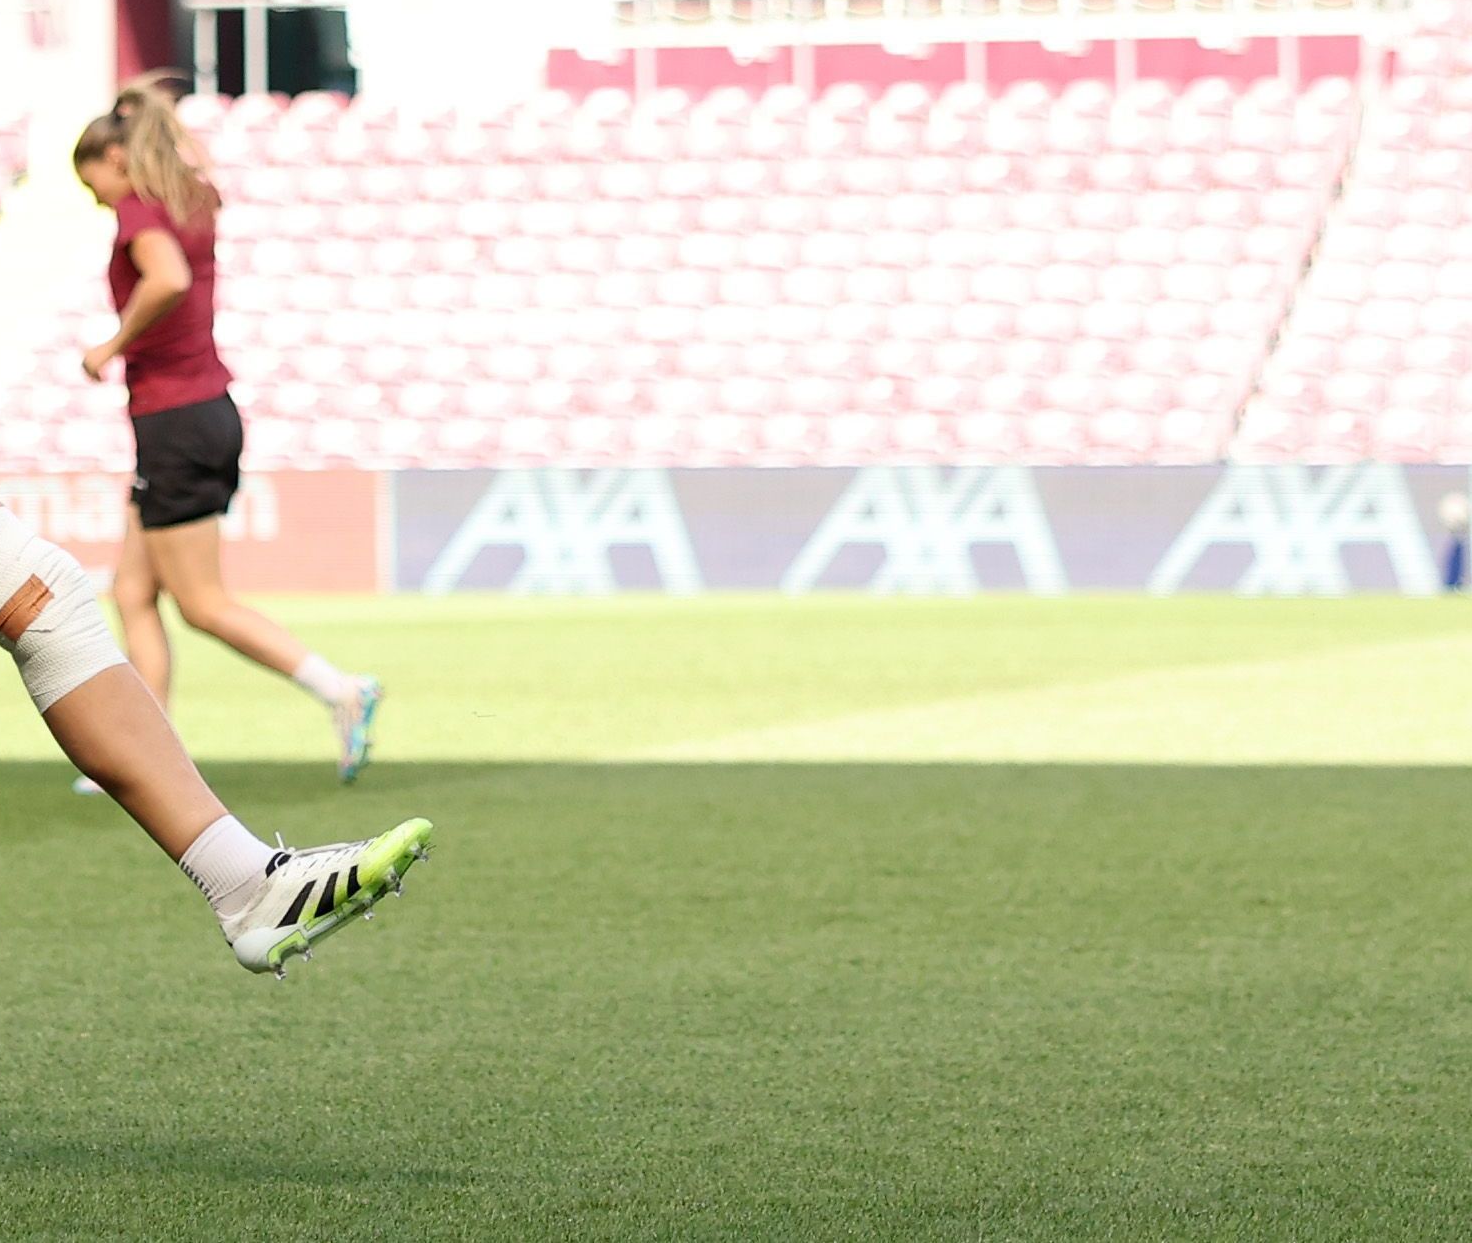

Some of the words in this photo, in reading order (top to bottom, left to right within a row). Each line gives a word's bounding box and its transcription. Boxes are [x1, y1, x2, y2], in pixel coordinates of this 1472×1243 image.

[421, 468, 701, 596] AXA
[779, 466, 1065, 596] AXA
[1146, 465, 1439, 596] AXA
